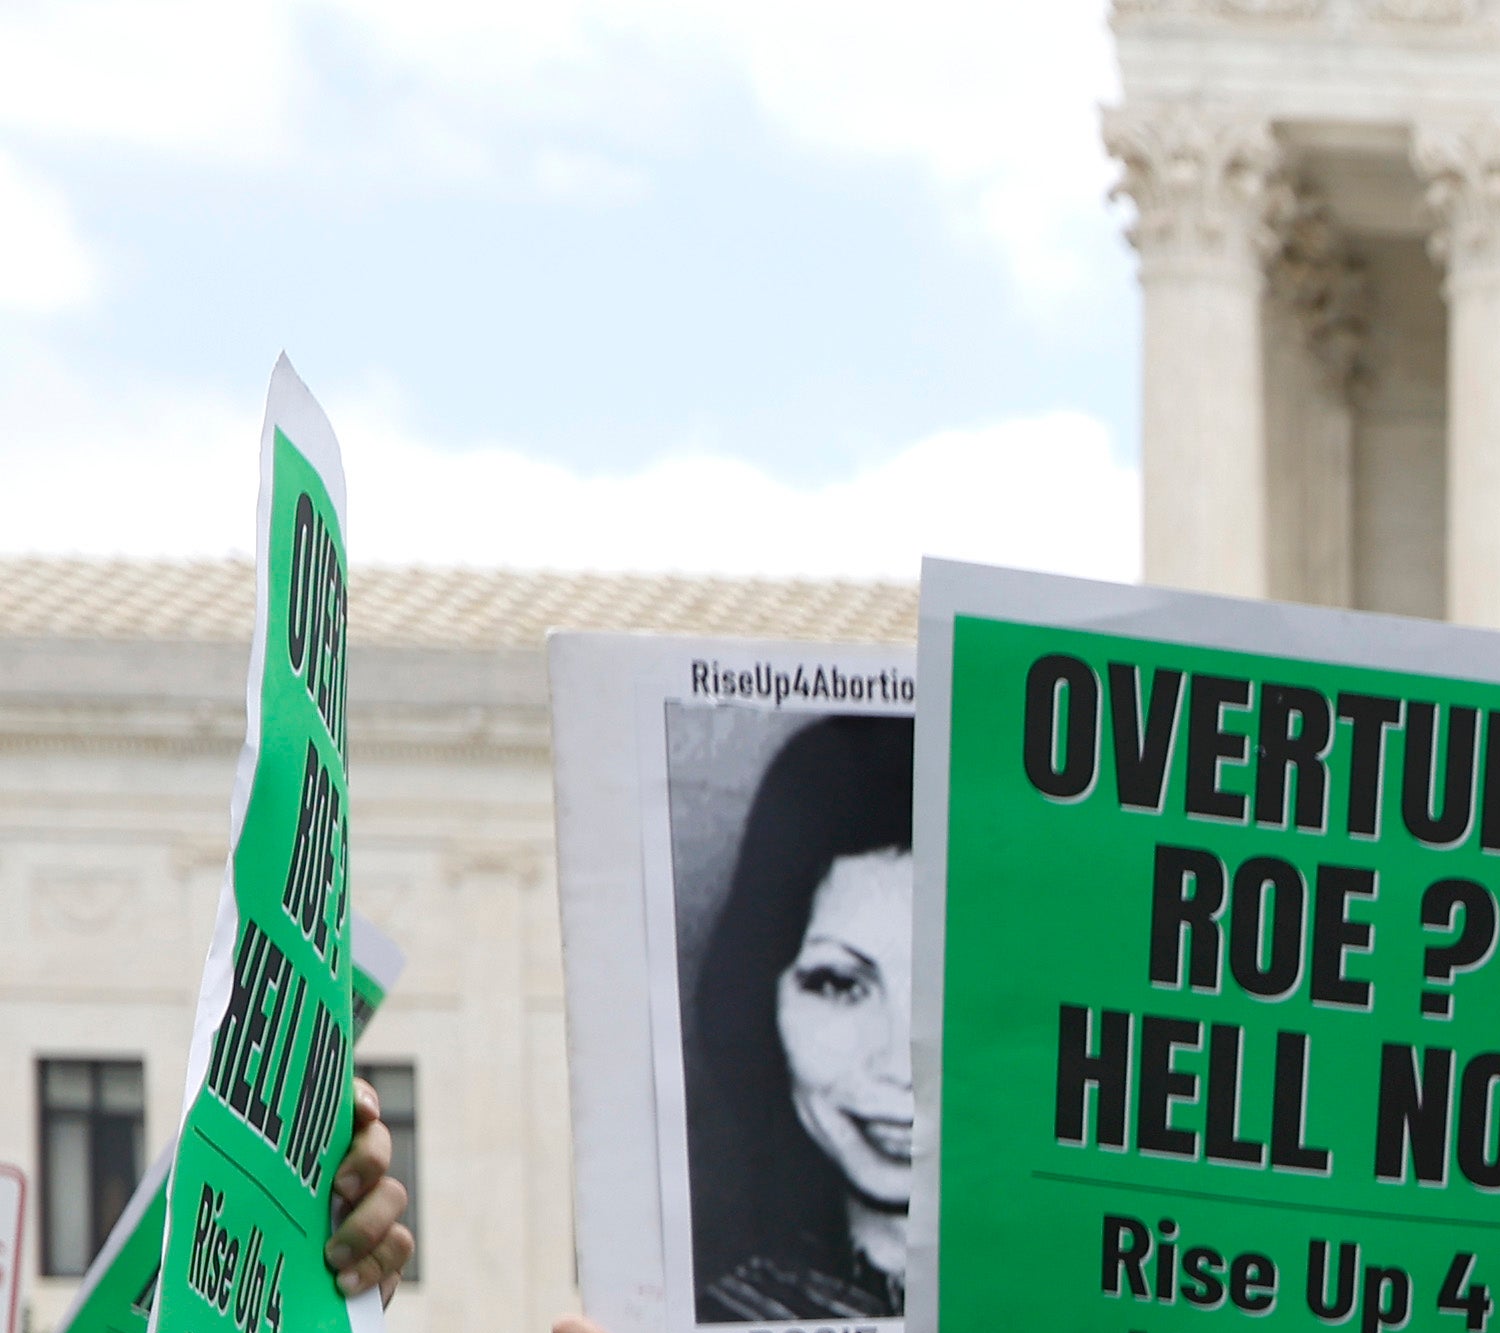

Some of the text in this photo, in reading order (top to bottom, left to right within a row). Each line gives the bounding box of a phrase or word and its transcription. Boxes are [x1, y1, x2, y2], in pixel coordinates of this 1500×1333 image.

[283, 737, 340, 964] ROE
[1149, 843, 1500, 1021] ROE ?
[206, 917, 307, 1154] HELL
[1054, 1003, 1331, 1176] HELL
[188, 1183, 239, 1317] Rise
[1102, 1213, 1278, 1316] Rise
